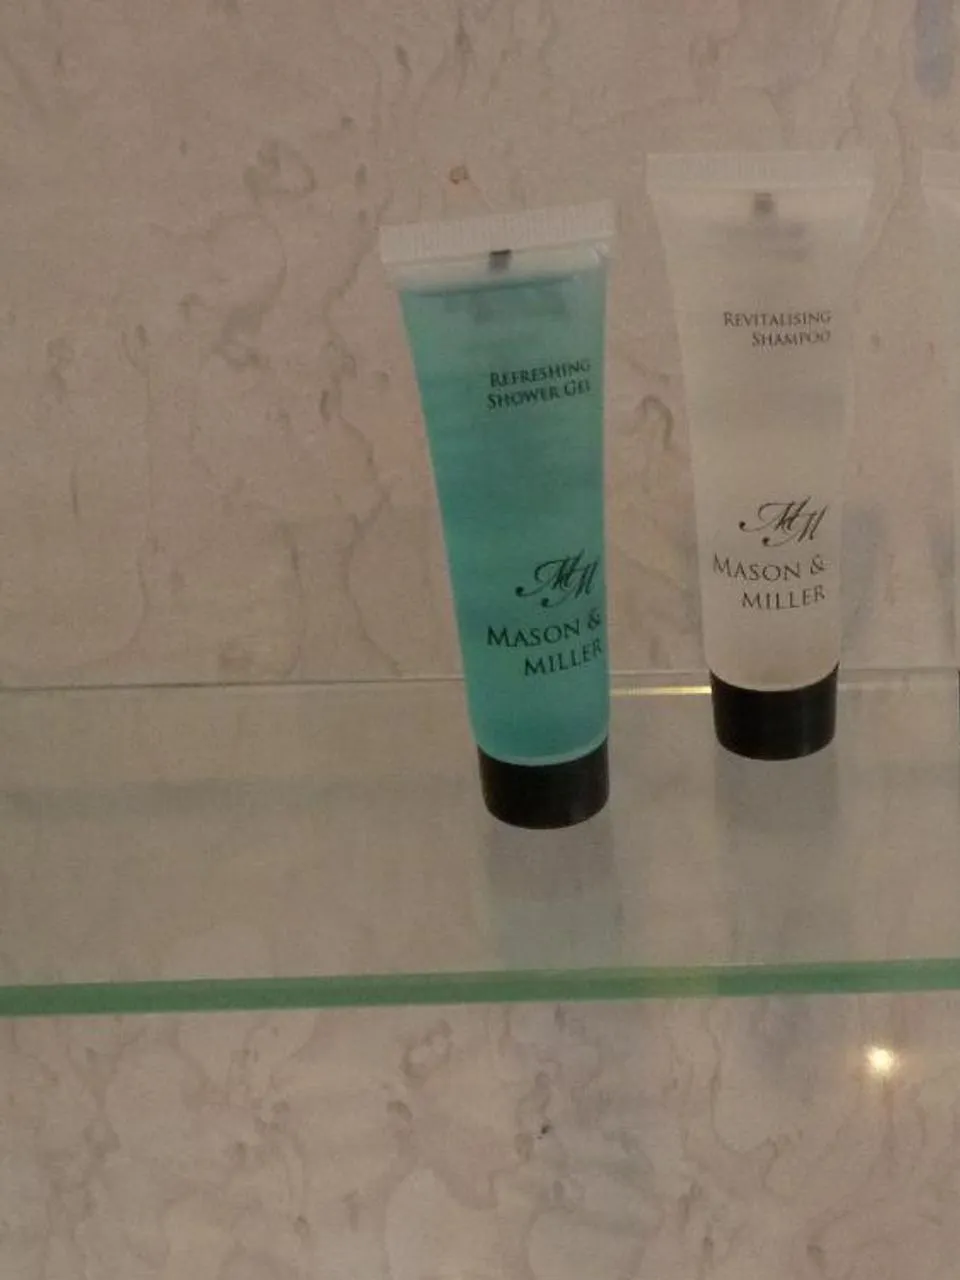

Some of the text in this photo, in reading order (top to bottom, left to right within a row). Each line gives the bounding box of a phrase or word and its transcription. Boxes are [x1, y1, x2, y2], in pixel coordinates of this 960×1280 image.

[723, 310, 832, 328] REVITALISING
[751, 330, 831, 348] SHAMPOO
[489, 360, 591, 388] REFRESHING
[487, 378, 592, 410] SHOWER GEL
[713, 552, 826, 581] MASON &
[741, 586, 826, 611] MILLER
[486, 608, 604, 649] MASON &
[523, 639, 604, 677] MILLER
